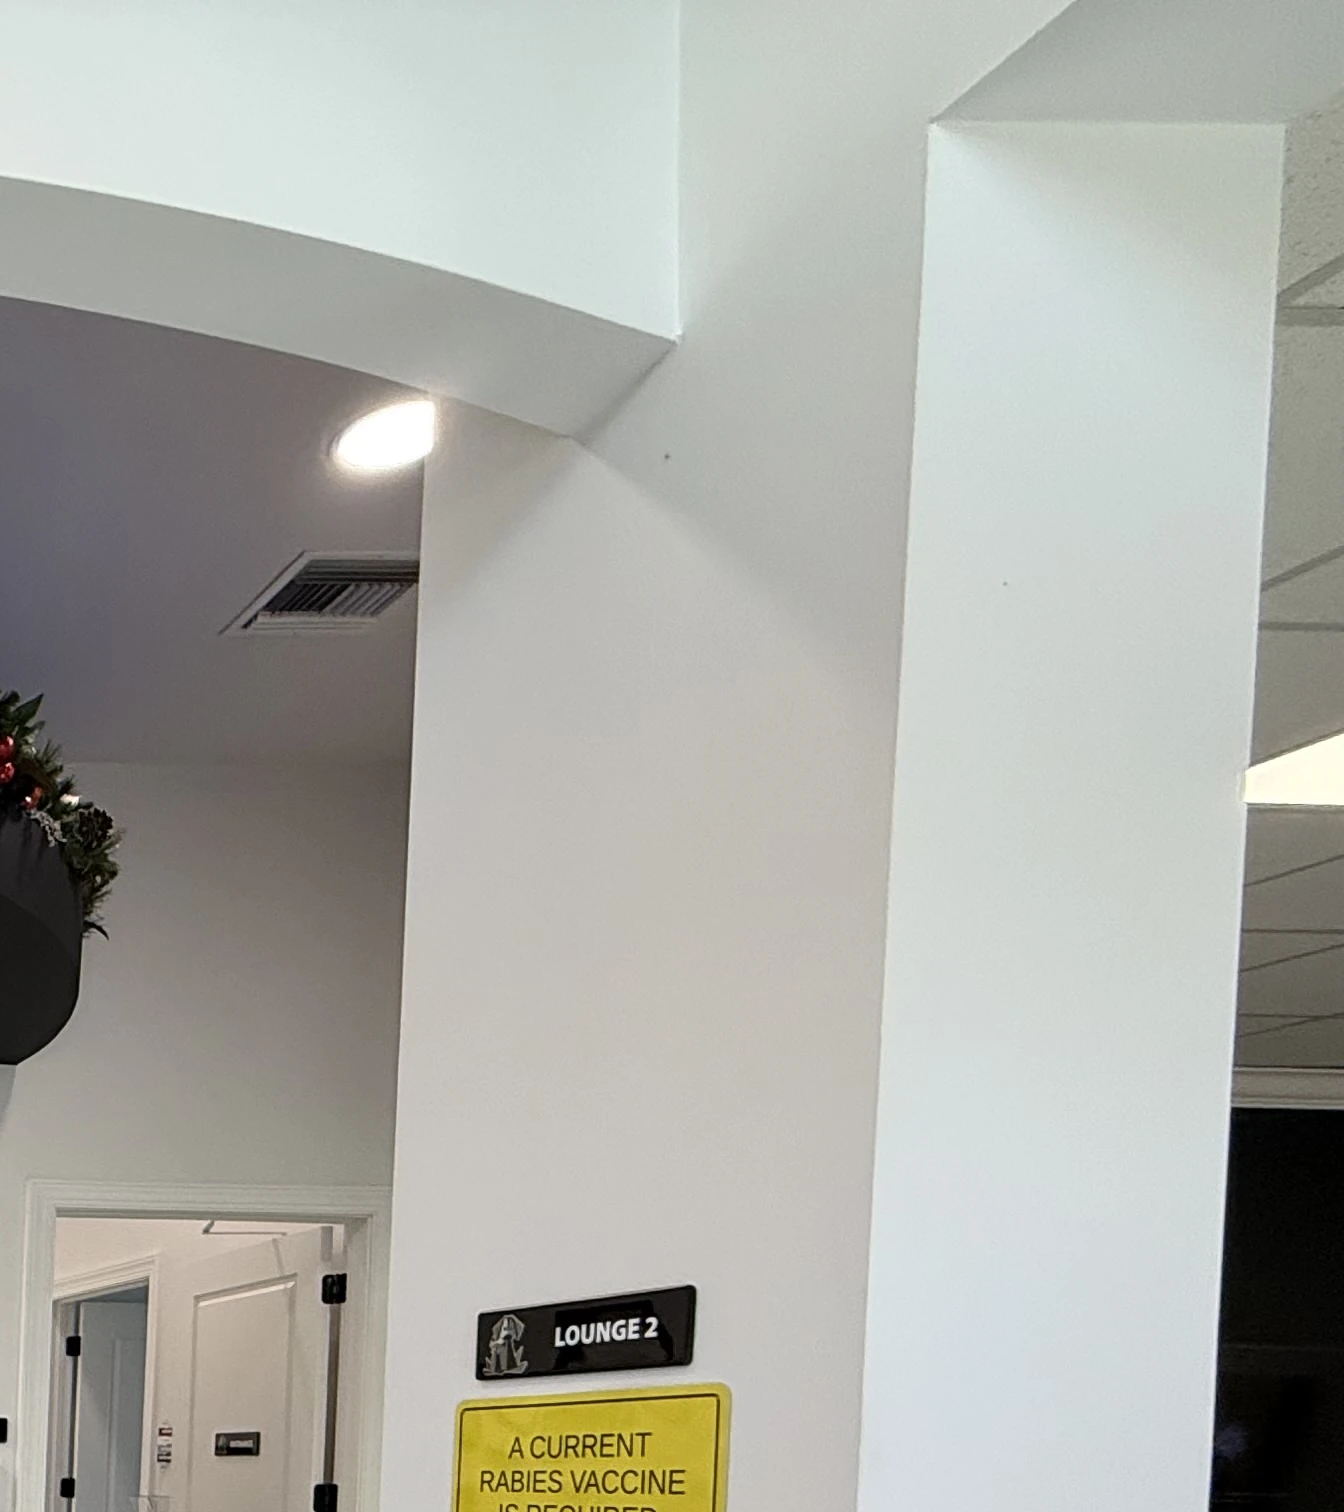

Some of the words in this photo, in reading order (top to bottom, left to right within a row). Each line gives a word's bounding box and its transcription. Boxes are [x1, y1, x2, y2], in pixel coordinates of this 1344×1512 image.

[554, 1318, 640, 1348] LOUNGE
[643, 1316, 659, 1338] 2
[508, 1436, 524, 1460] A
[529, 1432, 652, 1459] CURRENT
[479, 1469, 563, 1494] RABIES
[570, 1469, 686, 1496] VACCINE
